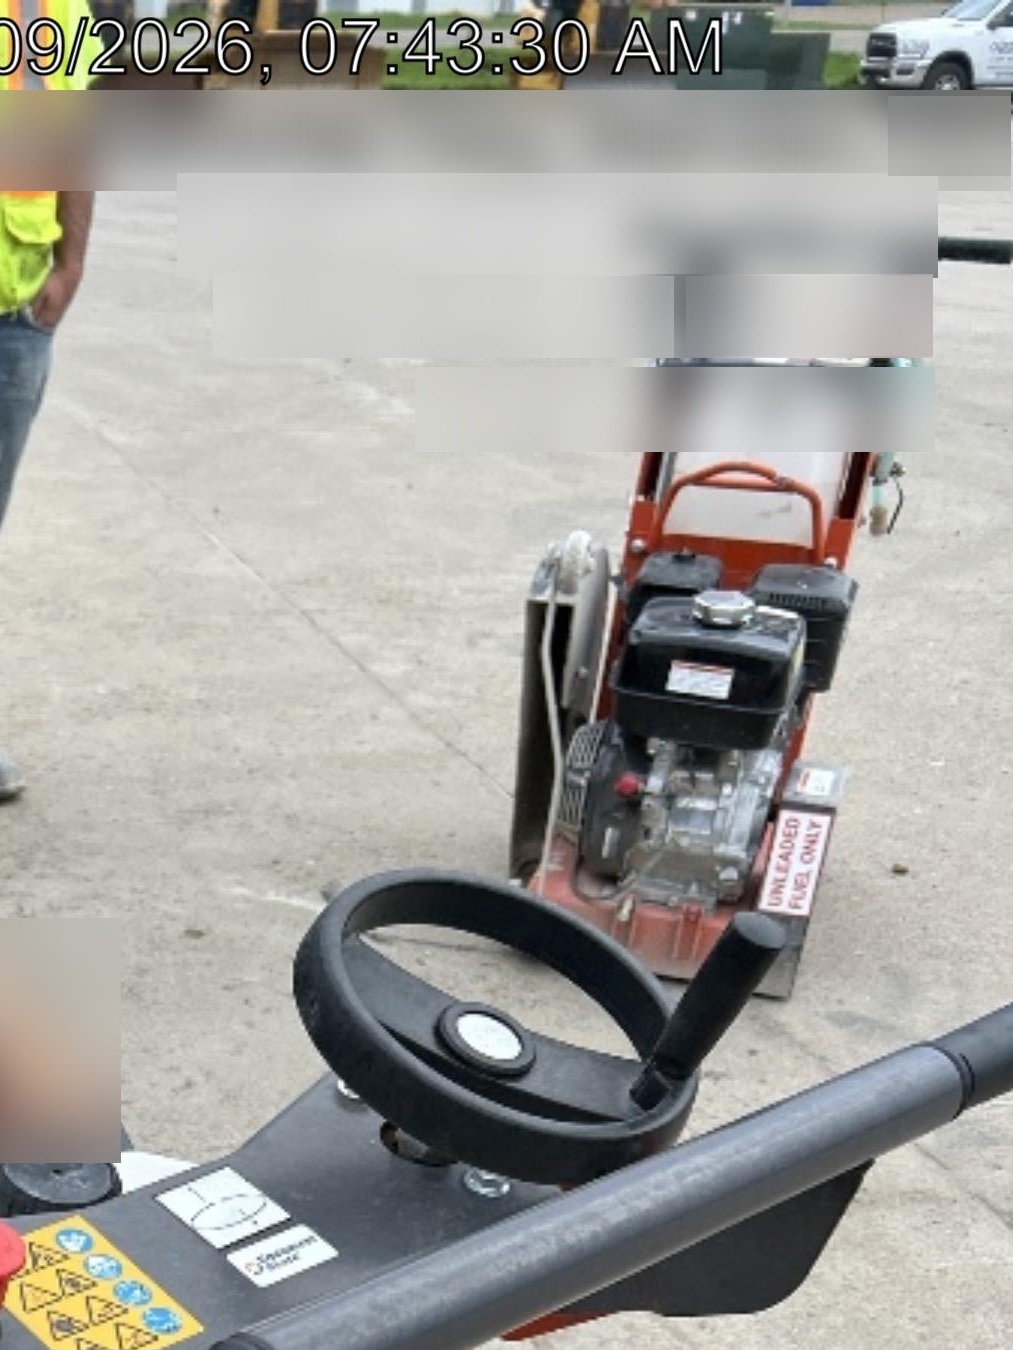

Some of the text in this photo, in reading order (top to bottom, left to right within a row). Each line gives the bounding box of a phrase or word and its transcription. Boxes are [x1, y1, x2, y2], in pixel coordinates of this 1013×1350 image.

[768, 817, 801, 907] UNLEADED
[800, 819, 823, 865] ONLY
[789, 870, 812, 910] FUEL
